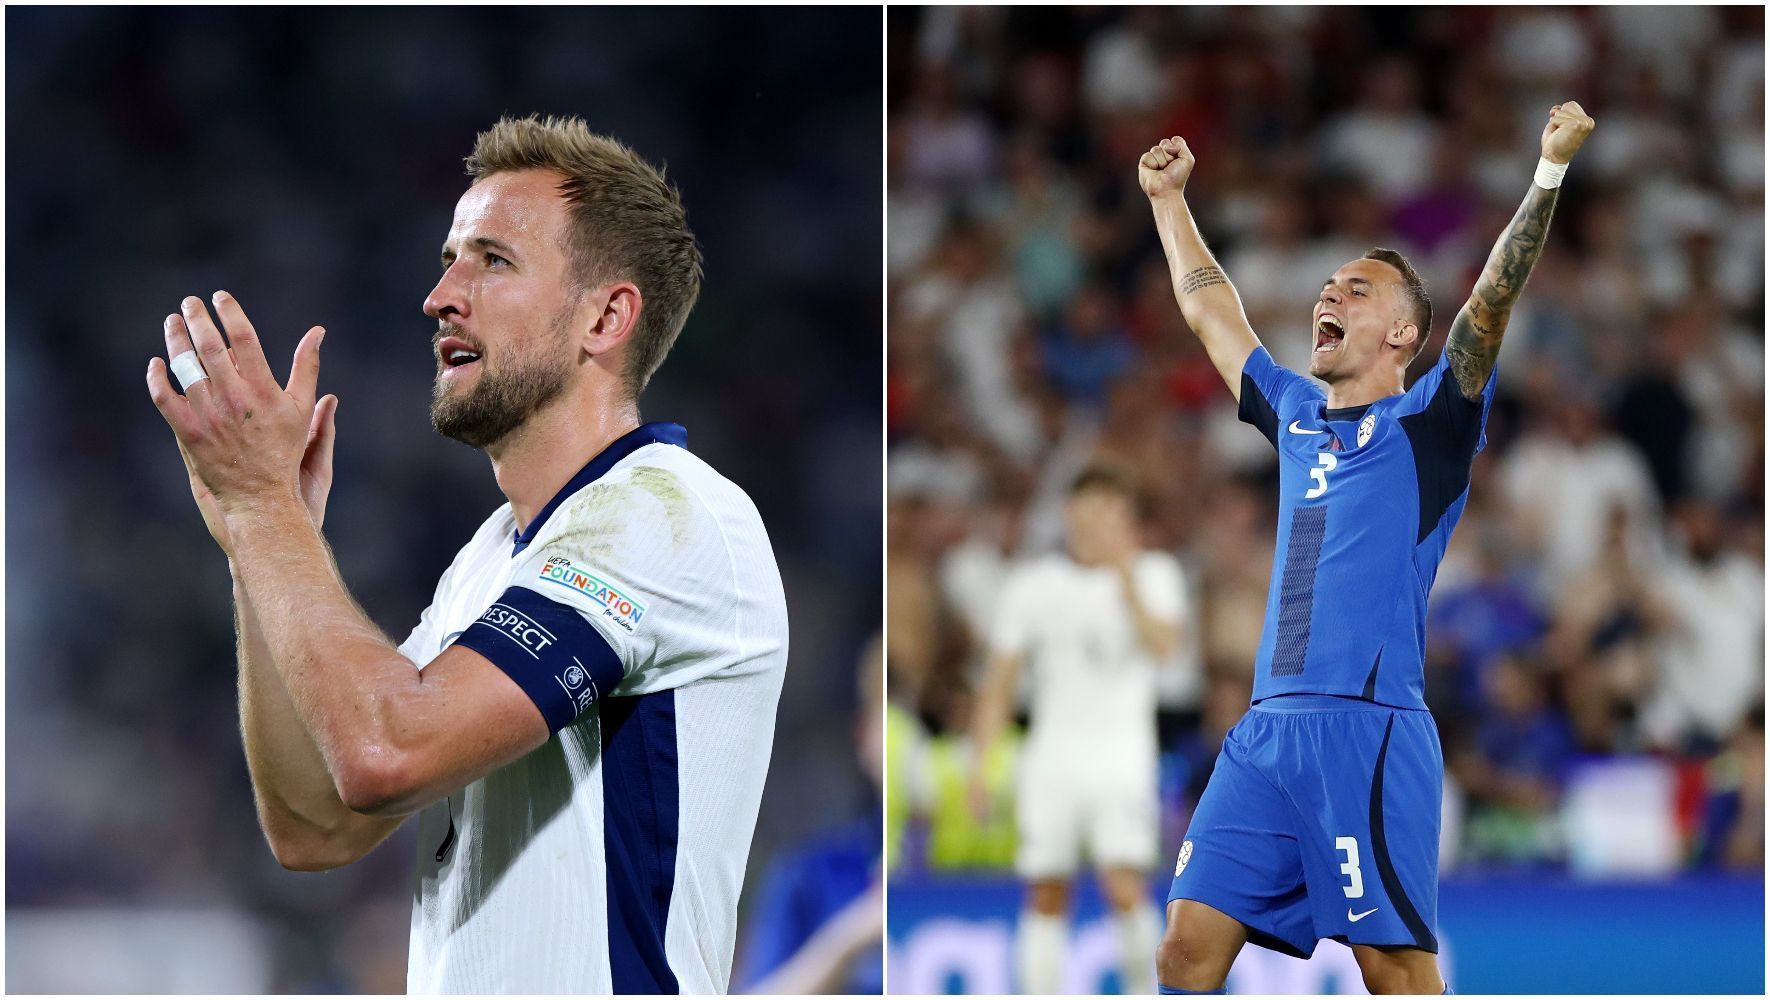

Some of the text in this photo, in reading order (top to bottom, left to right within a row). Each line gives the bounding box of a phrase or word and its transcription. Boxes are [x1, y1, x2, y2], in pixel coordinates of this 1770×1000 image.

[1305, 452, 1338, 499] 3
[547, 556, 571, 568] UEFA
[603, 608, 633, 632] for children
[1335, 836, 1364, 898] 3
